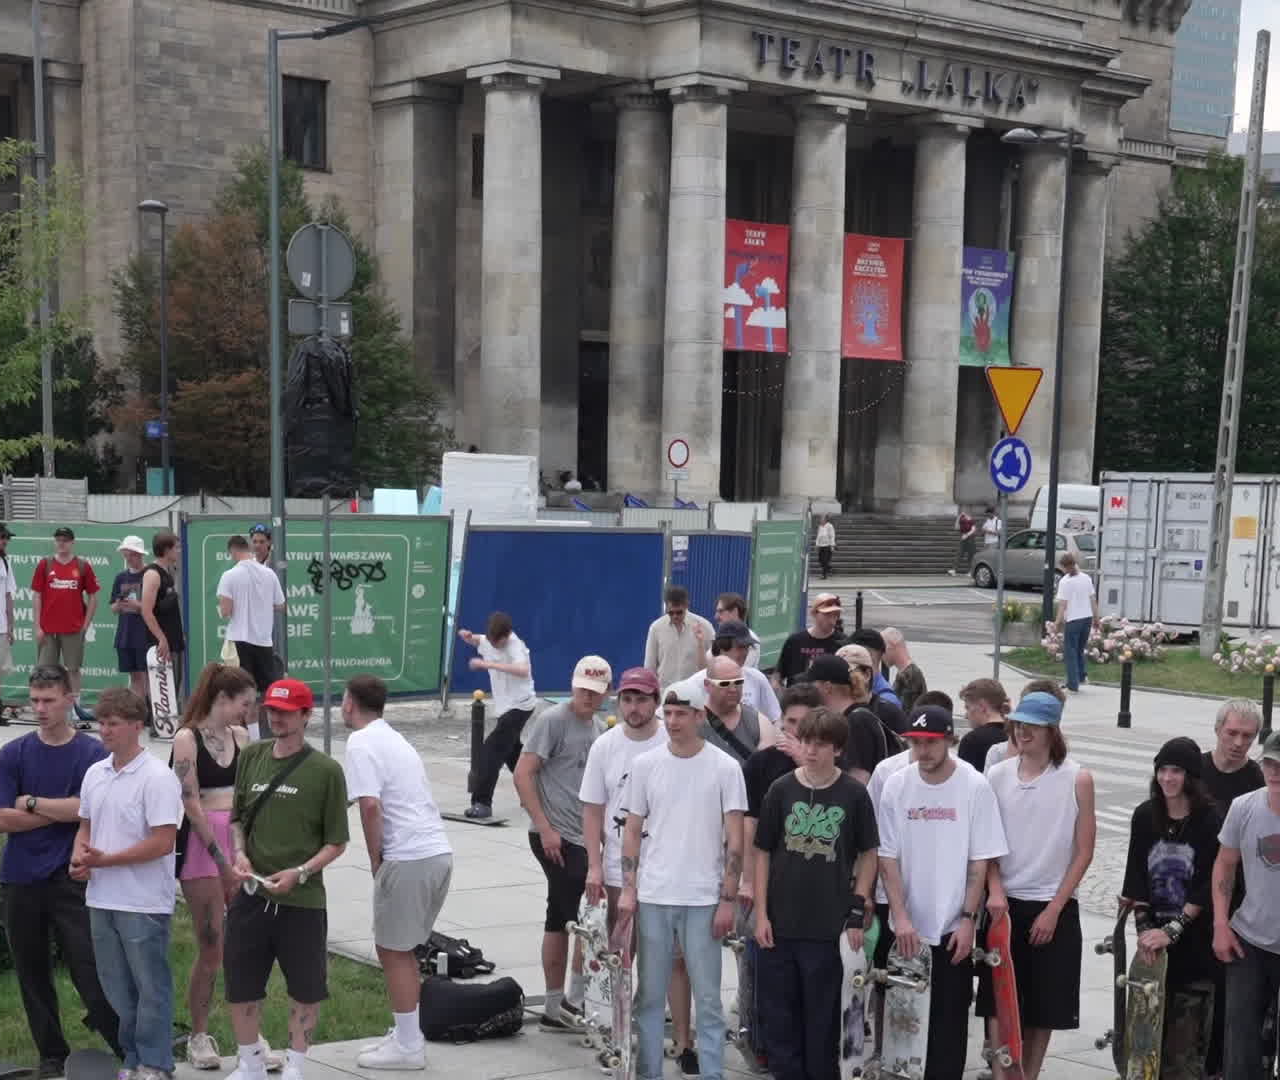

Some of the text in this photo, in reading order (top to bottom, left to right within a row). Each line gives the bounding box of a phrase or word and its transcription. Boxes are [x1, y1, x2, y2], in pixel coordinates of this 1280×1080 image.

[752, 31, 875, 90] TEATR
[329, 551, 393, 562] WARSZAWA
[584, 668, 607, 678] RAW
